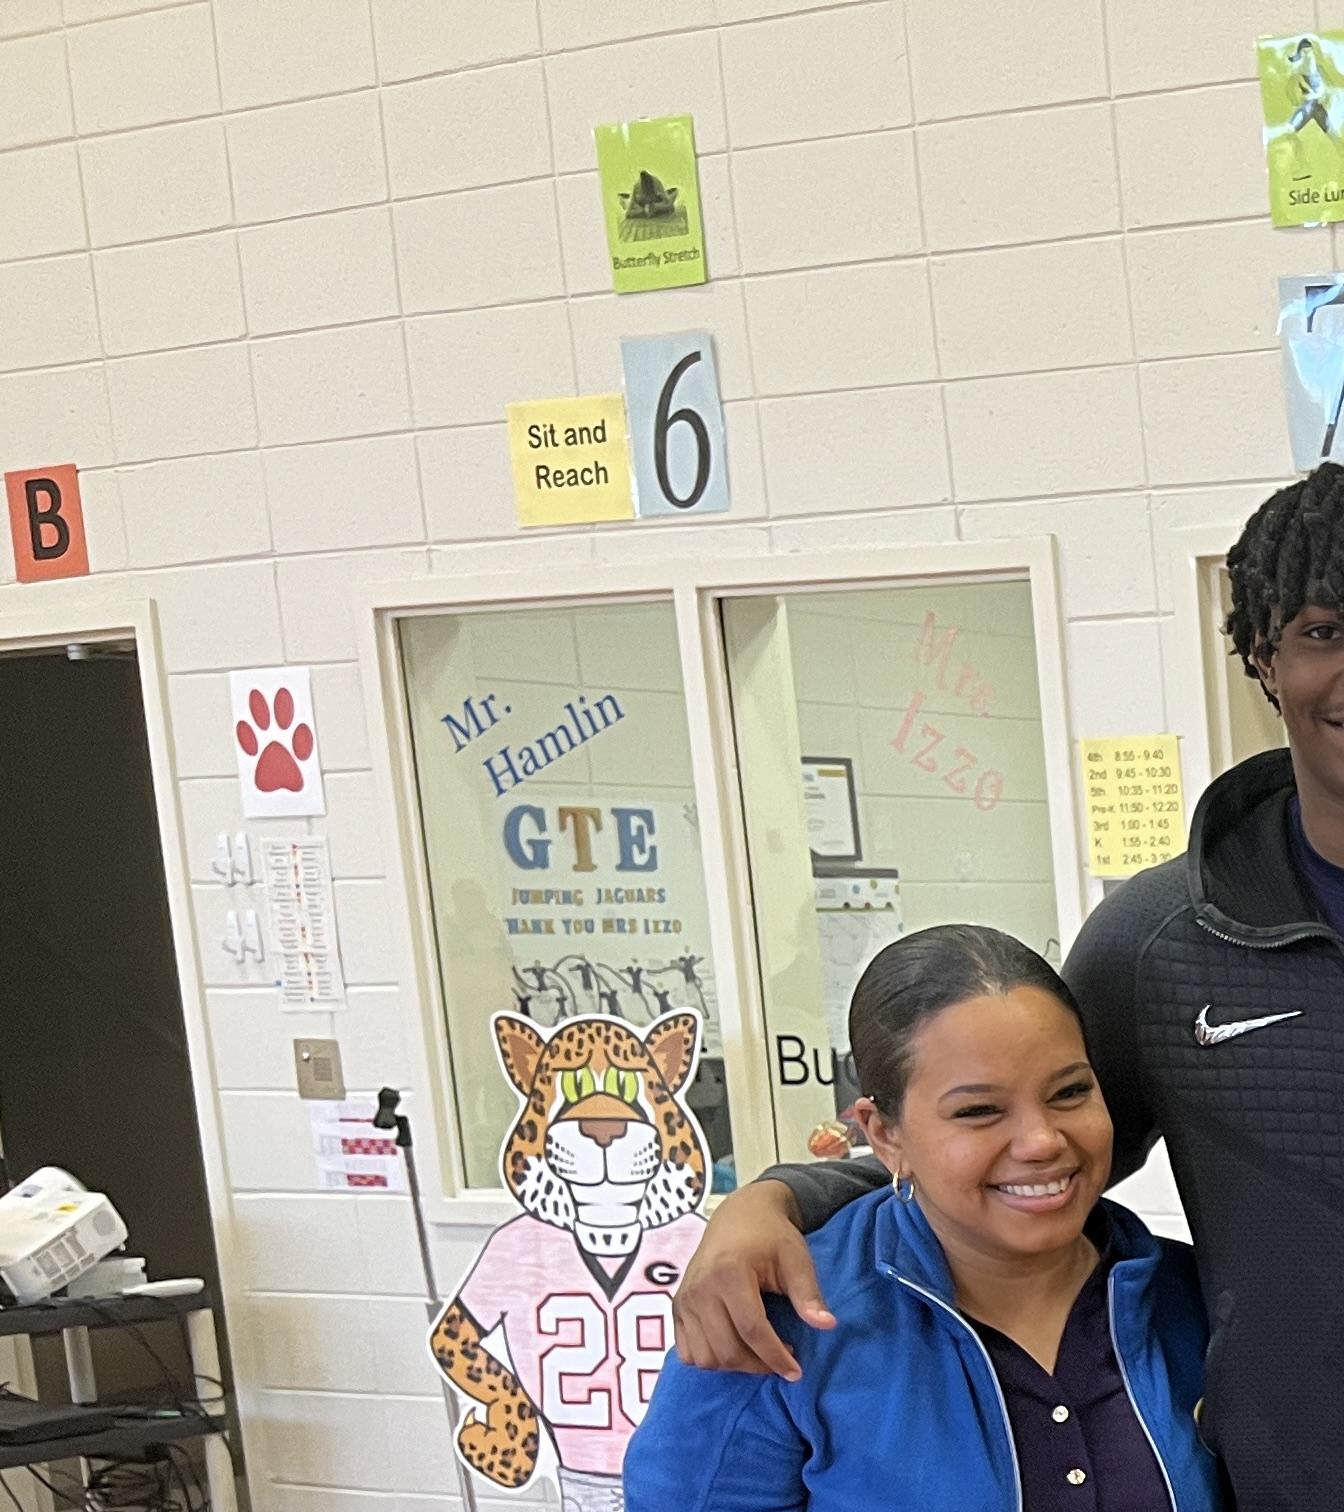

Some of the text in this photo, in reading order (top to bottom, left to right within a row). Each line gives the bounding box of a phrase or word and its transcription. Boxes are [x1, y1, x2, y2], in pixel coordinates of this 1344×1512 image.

[1289, 188, 1320, 206] Side
[612, 246, 700, 270] Butterfly Stretch
[528, 418, 607, 449] Sit and
[653, 350, 713, 510] 6
[535, 460, 609, 490] Reach
[25, 477, 70, 561] B
[440, 693, 512, 754] Mr.
[482, 694, 625, 798] Hamlin
[1089, 769, 1107, 780] 2nd
[503, 804, 658, 872] GTE
[512, 887, 667, 906] JUMPING JAGUARS
[561, 918, 595, 935] YOU
[644, 1260, 680, 1286] G
[537, 1290, 676, 1430] 28
